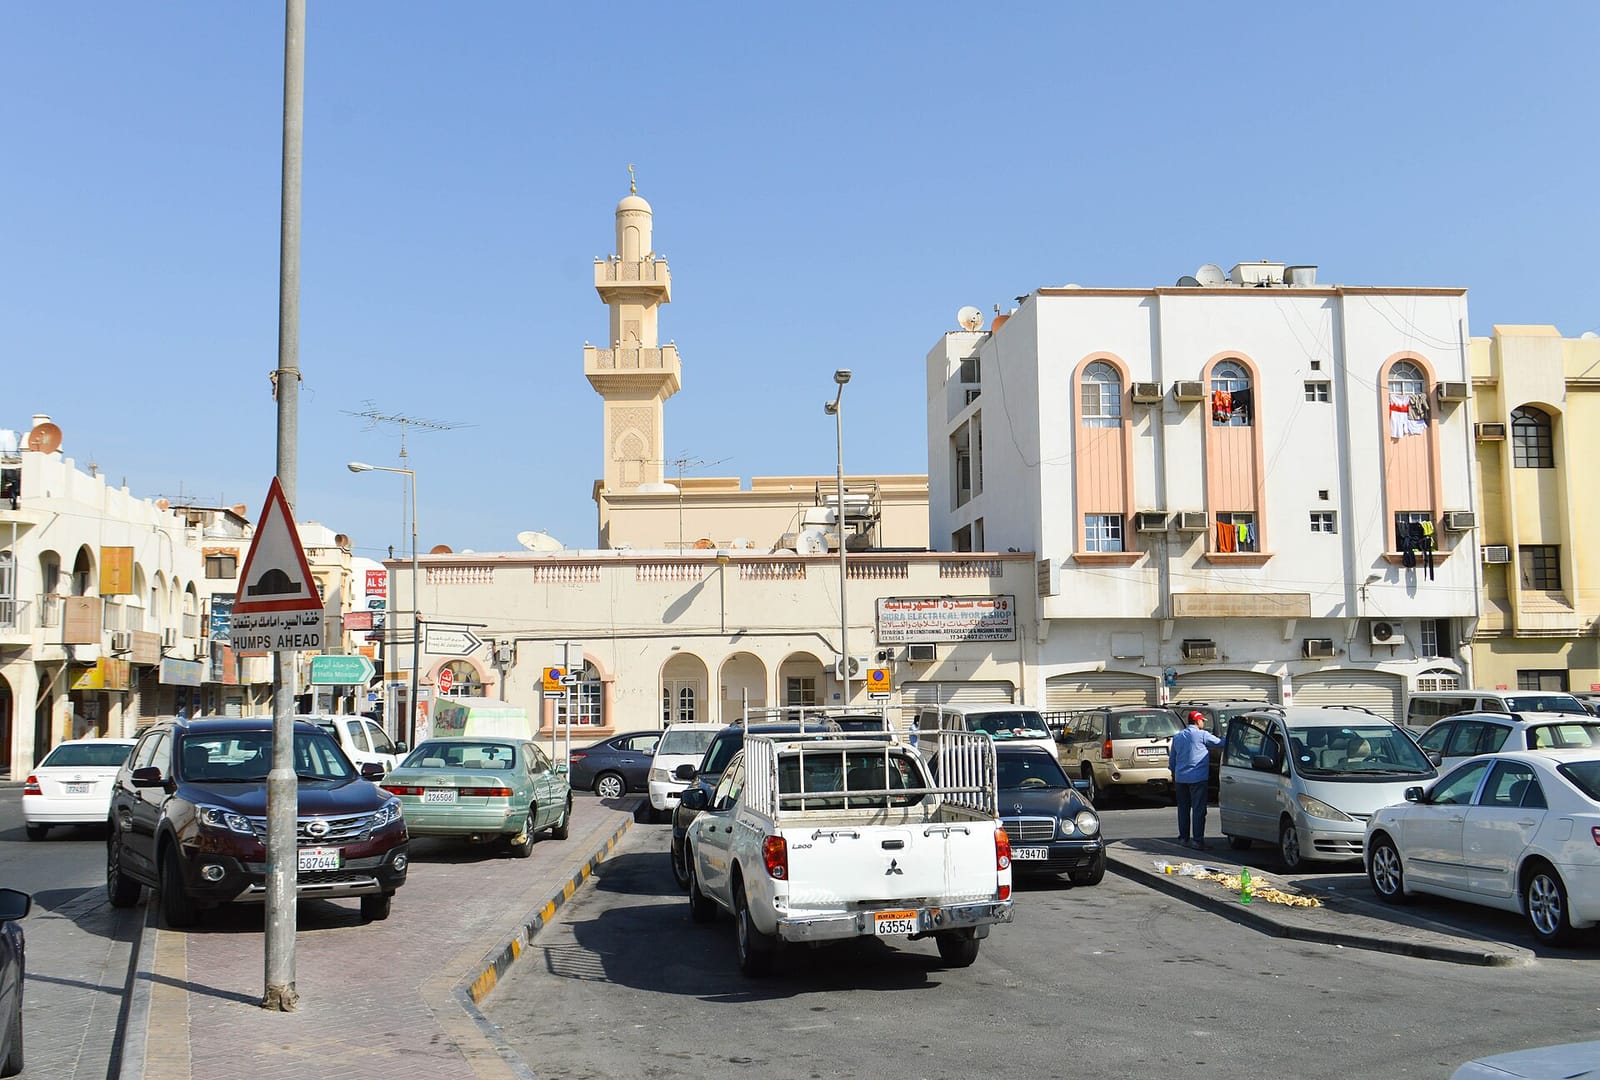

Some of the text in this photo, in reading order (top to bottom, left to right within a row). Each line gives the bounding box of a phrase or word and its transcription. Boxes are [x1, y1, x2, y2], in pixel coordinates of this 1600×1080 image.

[907, 611, 960, 621] ELECTRICAL
[987, 610, 1012, 619] SHOP
[233, 633, 320, 649] HUMPS AHEAD
[441, 679, 451, 688] STOP
[1019, 849, 1047, 859] 29470
[299, 857, 337, 869] 587644
[879, 920, 913, 934] 63554
